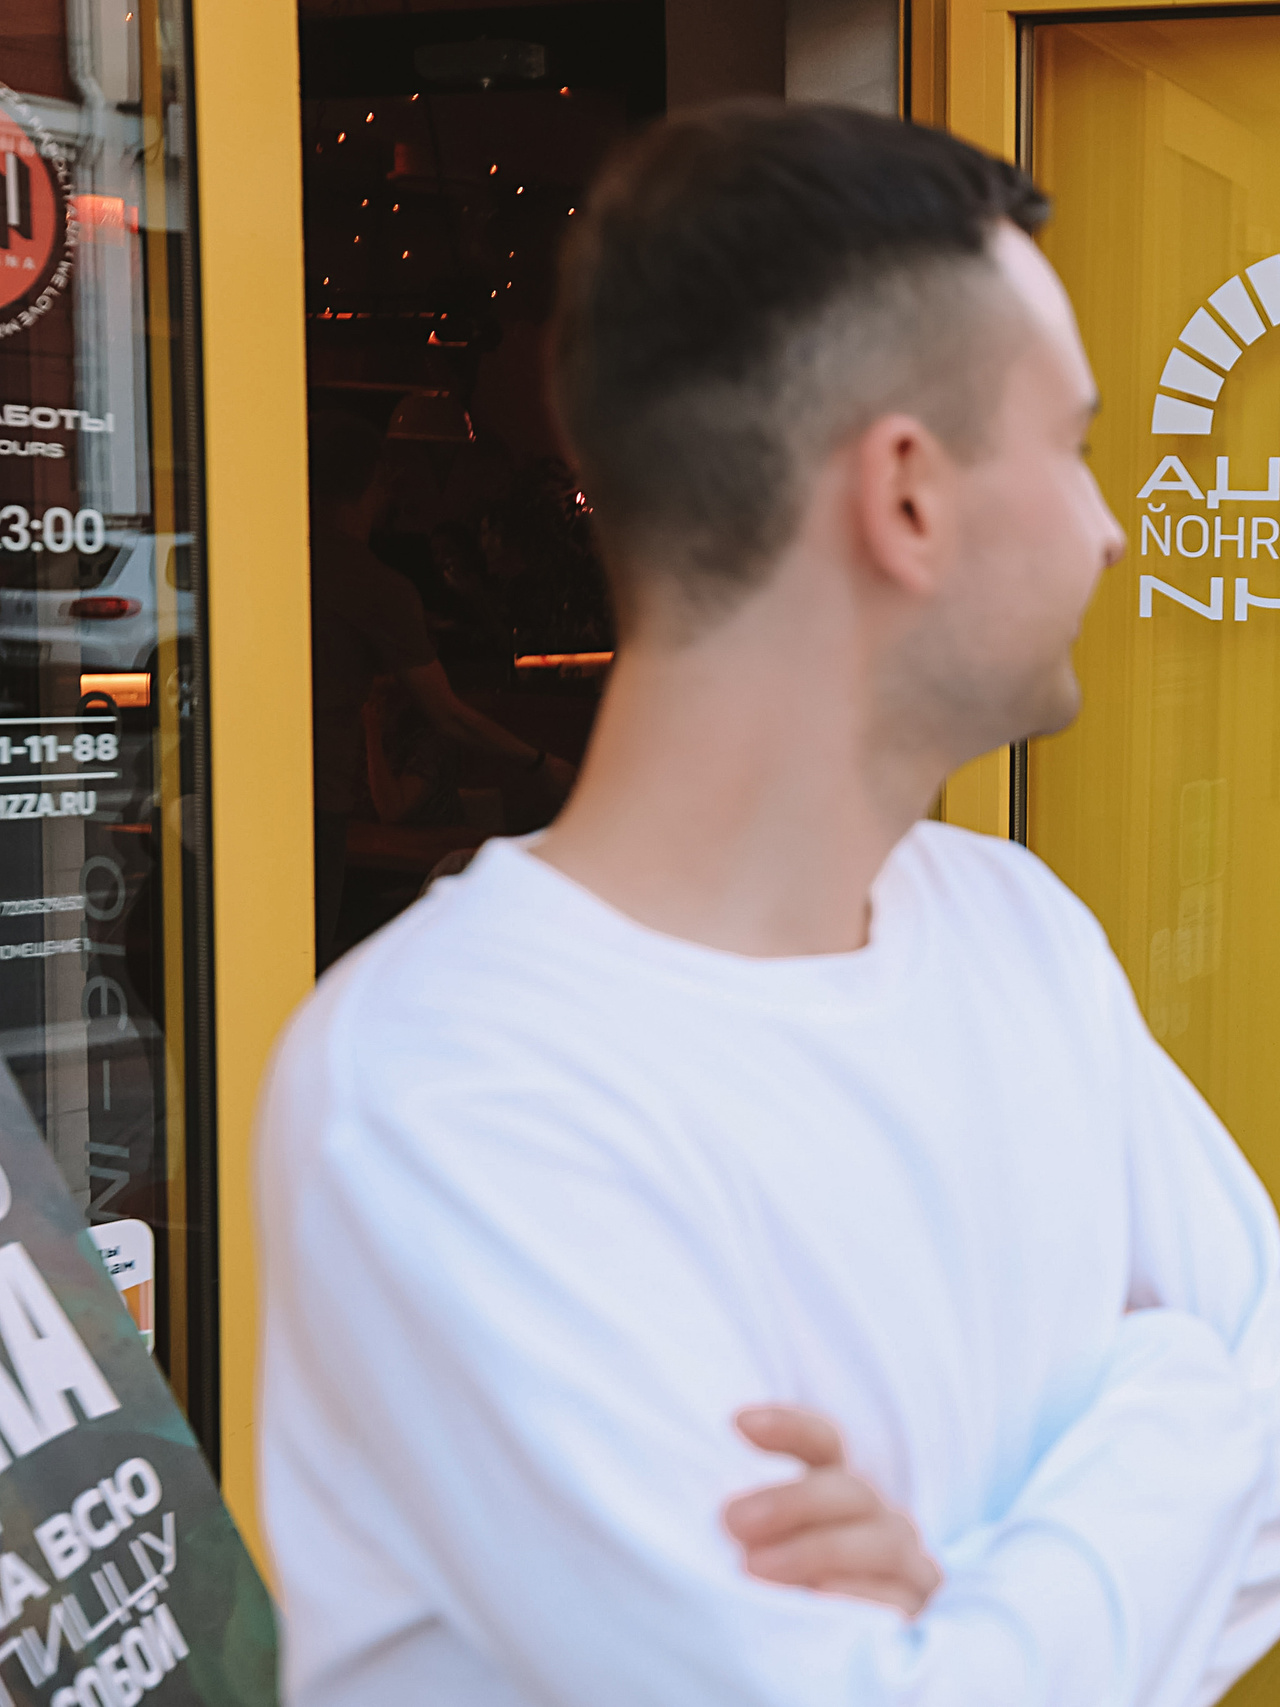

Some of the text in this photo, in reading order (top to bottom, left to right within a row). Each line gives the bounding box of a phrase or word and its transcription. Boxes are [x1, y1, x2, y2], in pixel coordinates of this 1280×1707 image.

[17, 286, 61, 327] LOVE
[0, 404, 115, 432] БОТЫ
[33, 1457, 162, 1582] ВСЮ
